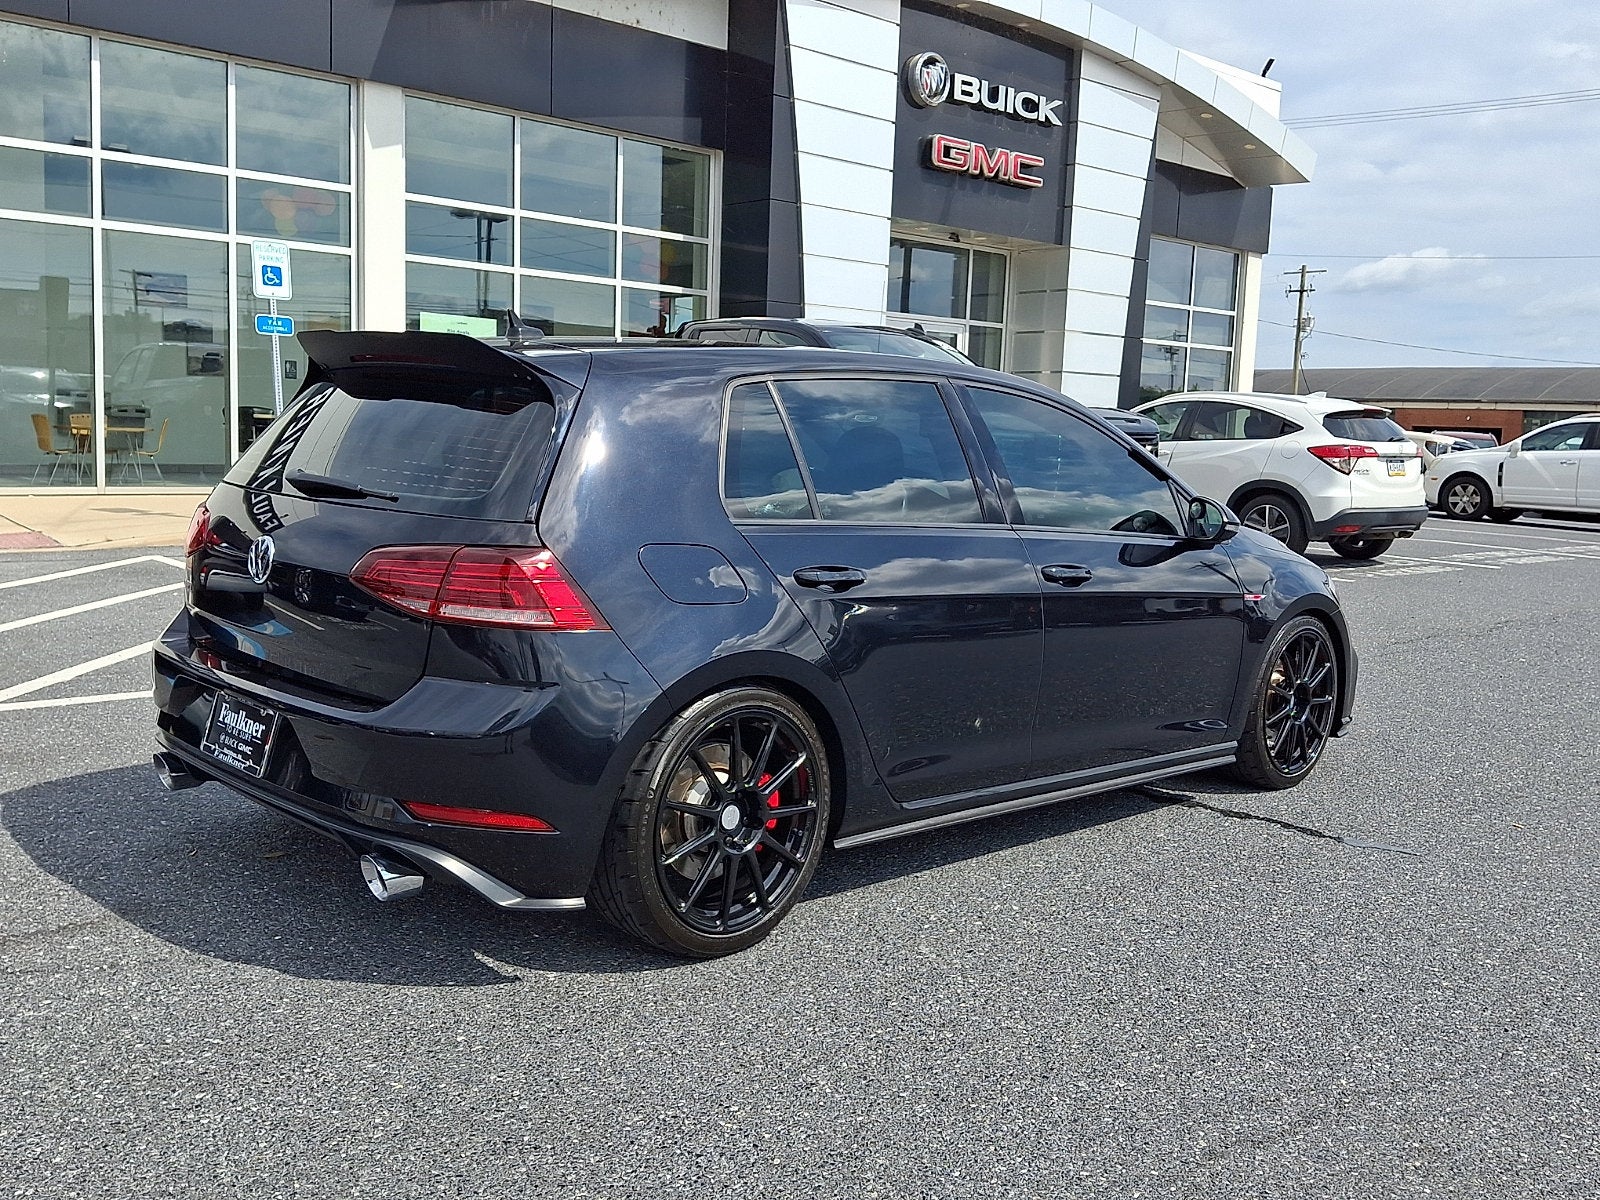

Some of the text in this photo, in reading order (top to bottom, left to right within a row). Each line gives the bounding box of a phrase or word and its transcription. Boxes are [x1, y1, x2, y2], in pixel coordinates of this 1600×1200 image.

[953, 72, 1064, 126] BUICK
[931, 134, 1045, 188] GMC
[255, 243, 286, 255] RESERVED
[258, 254, 284, 264] PARKING
[218, 702, 266, 739] Faulkner
[237, 742, 253, 755] GMC
[213, 749, 245, 770] Faulkner
